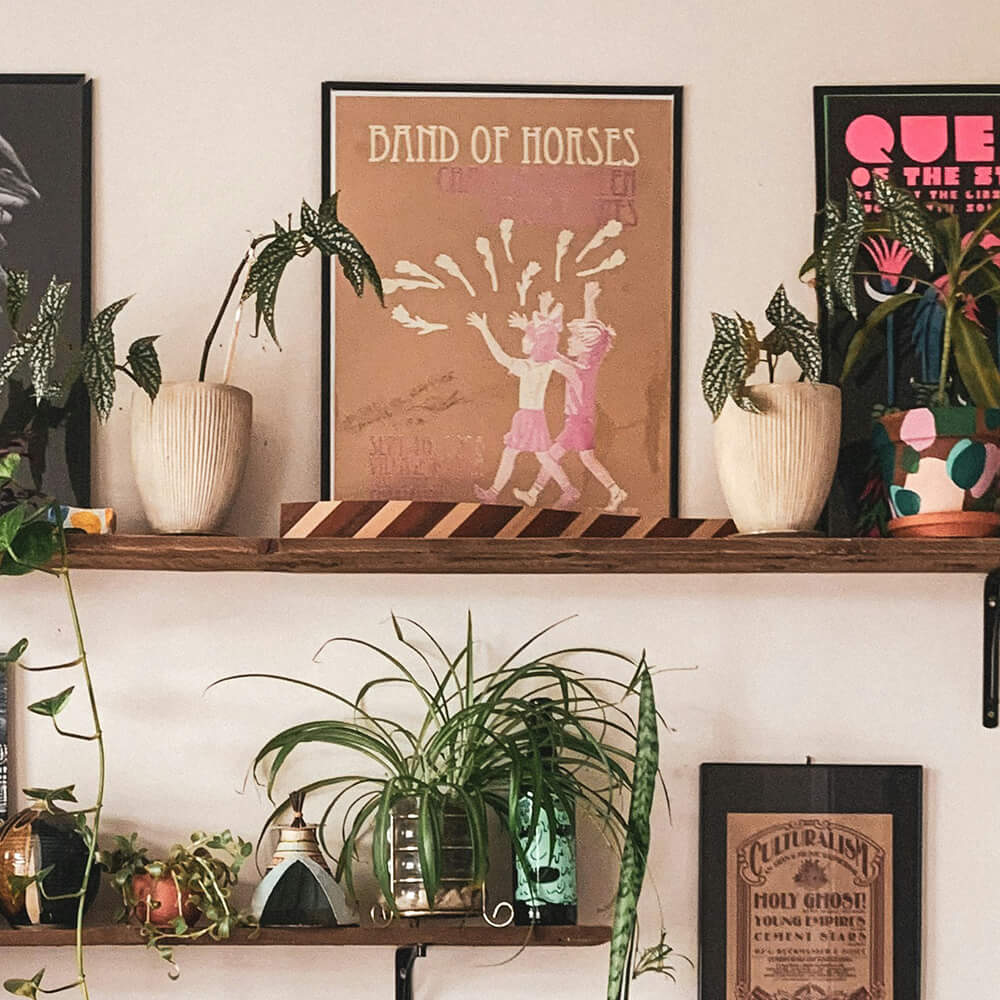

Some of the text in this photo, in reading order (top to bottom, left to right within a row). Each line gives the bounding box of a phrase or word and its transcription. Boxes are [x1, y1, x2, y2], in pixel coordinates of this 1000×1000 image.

[368, 125, 640, 166] BAND OF HORSES
[903, 166, 960, 186] THE
[929, 190, 958, 200] THE
[751, 829, 868, 877] CULTURALISM
[754, 892, 866, 909] HOLY GHOST!
[755, 915, 802, 928] YOUNG
[754, 932, 866, 942] CEMENT STARS
